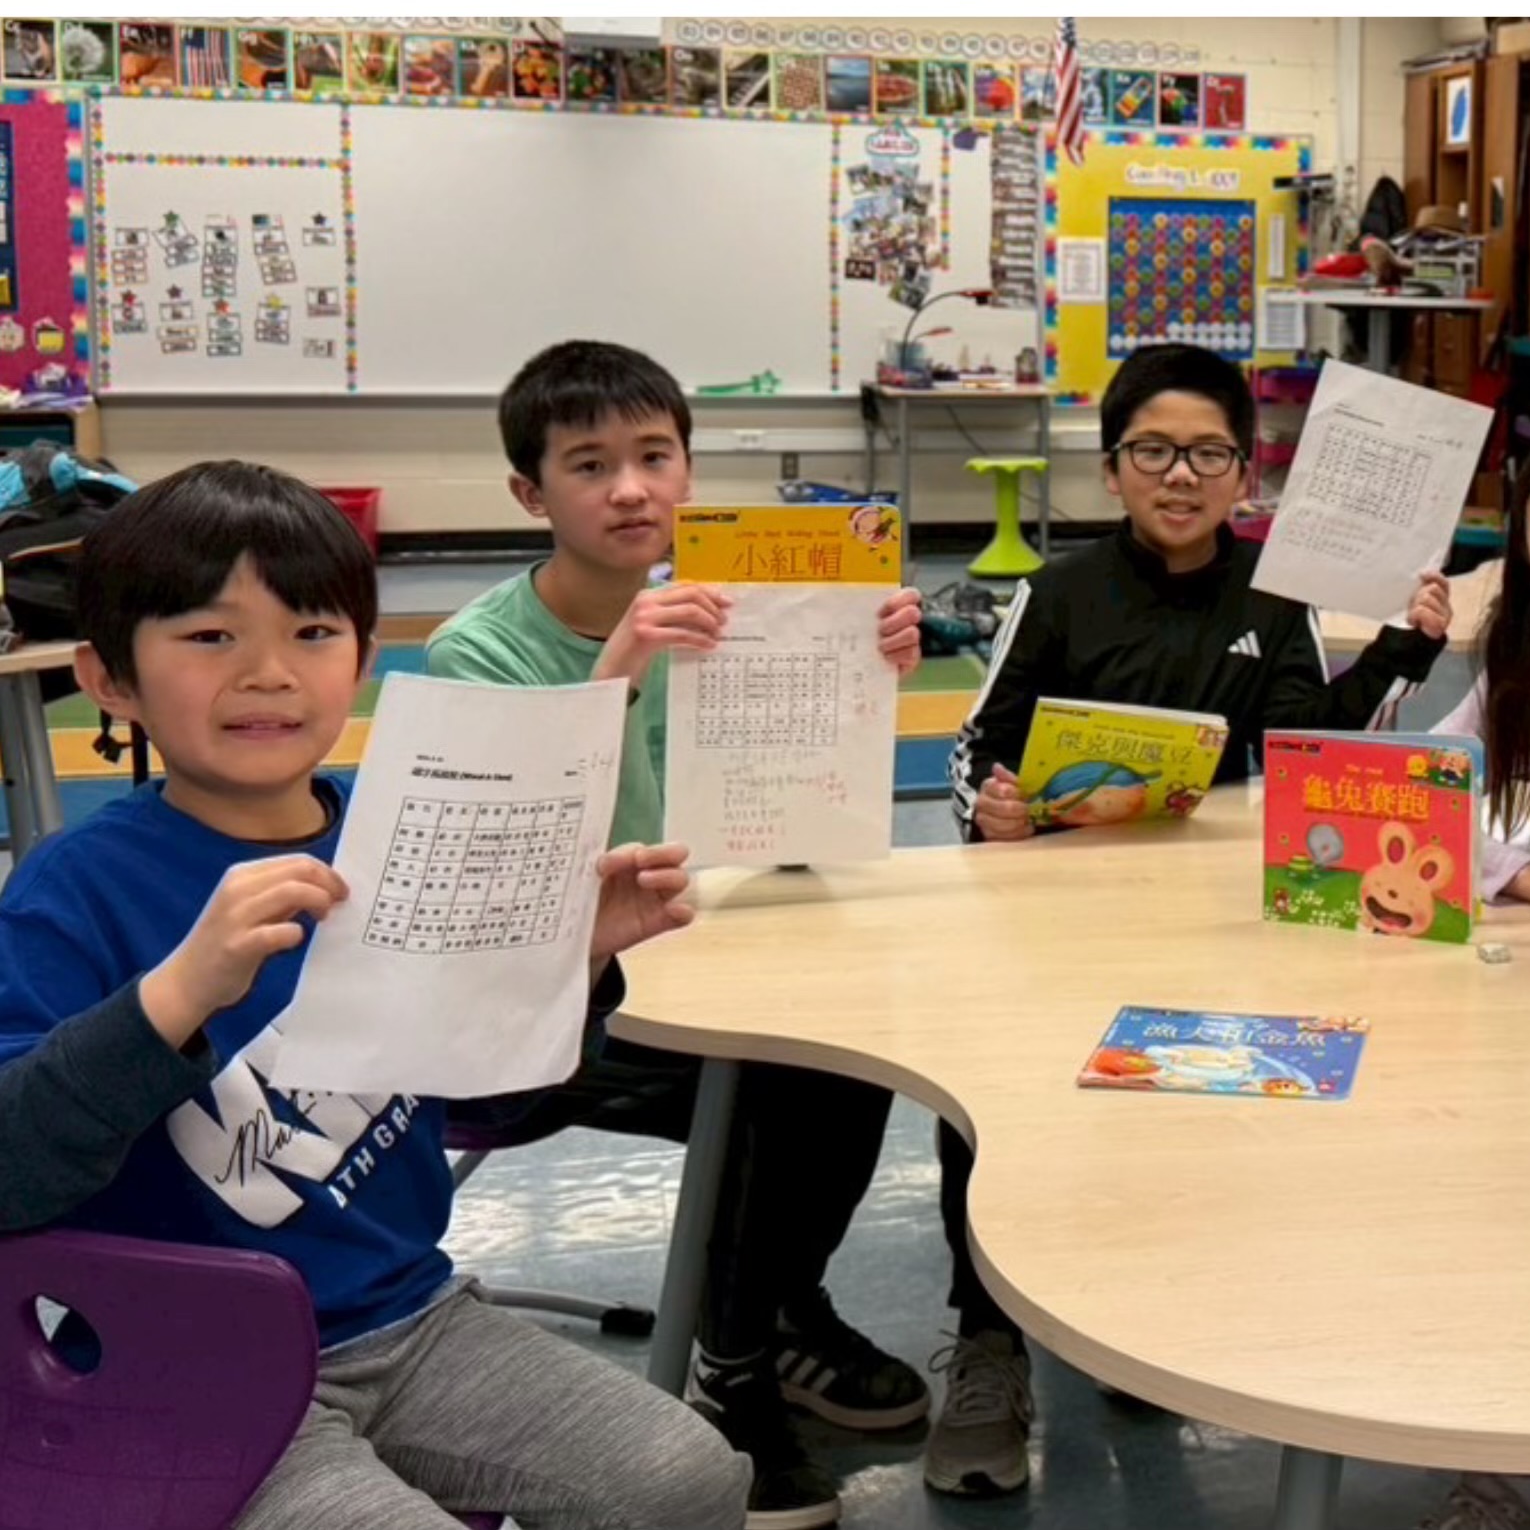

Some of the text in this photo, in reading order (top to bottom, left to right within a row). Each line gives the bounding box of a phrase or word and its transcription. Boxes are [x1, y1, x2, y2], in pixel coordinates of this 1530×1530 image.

[733, 543, 842, 577] 小紅帽
[1304, 774, 1430, 820] 龜兔賽跑
